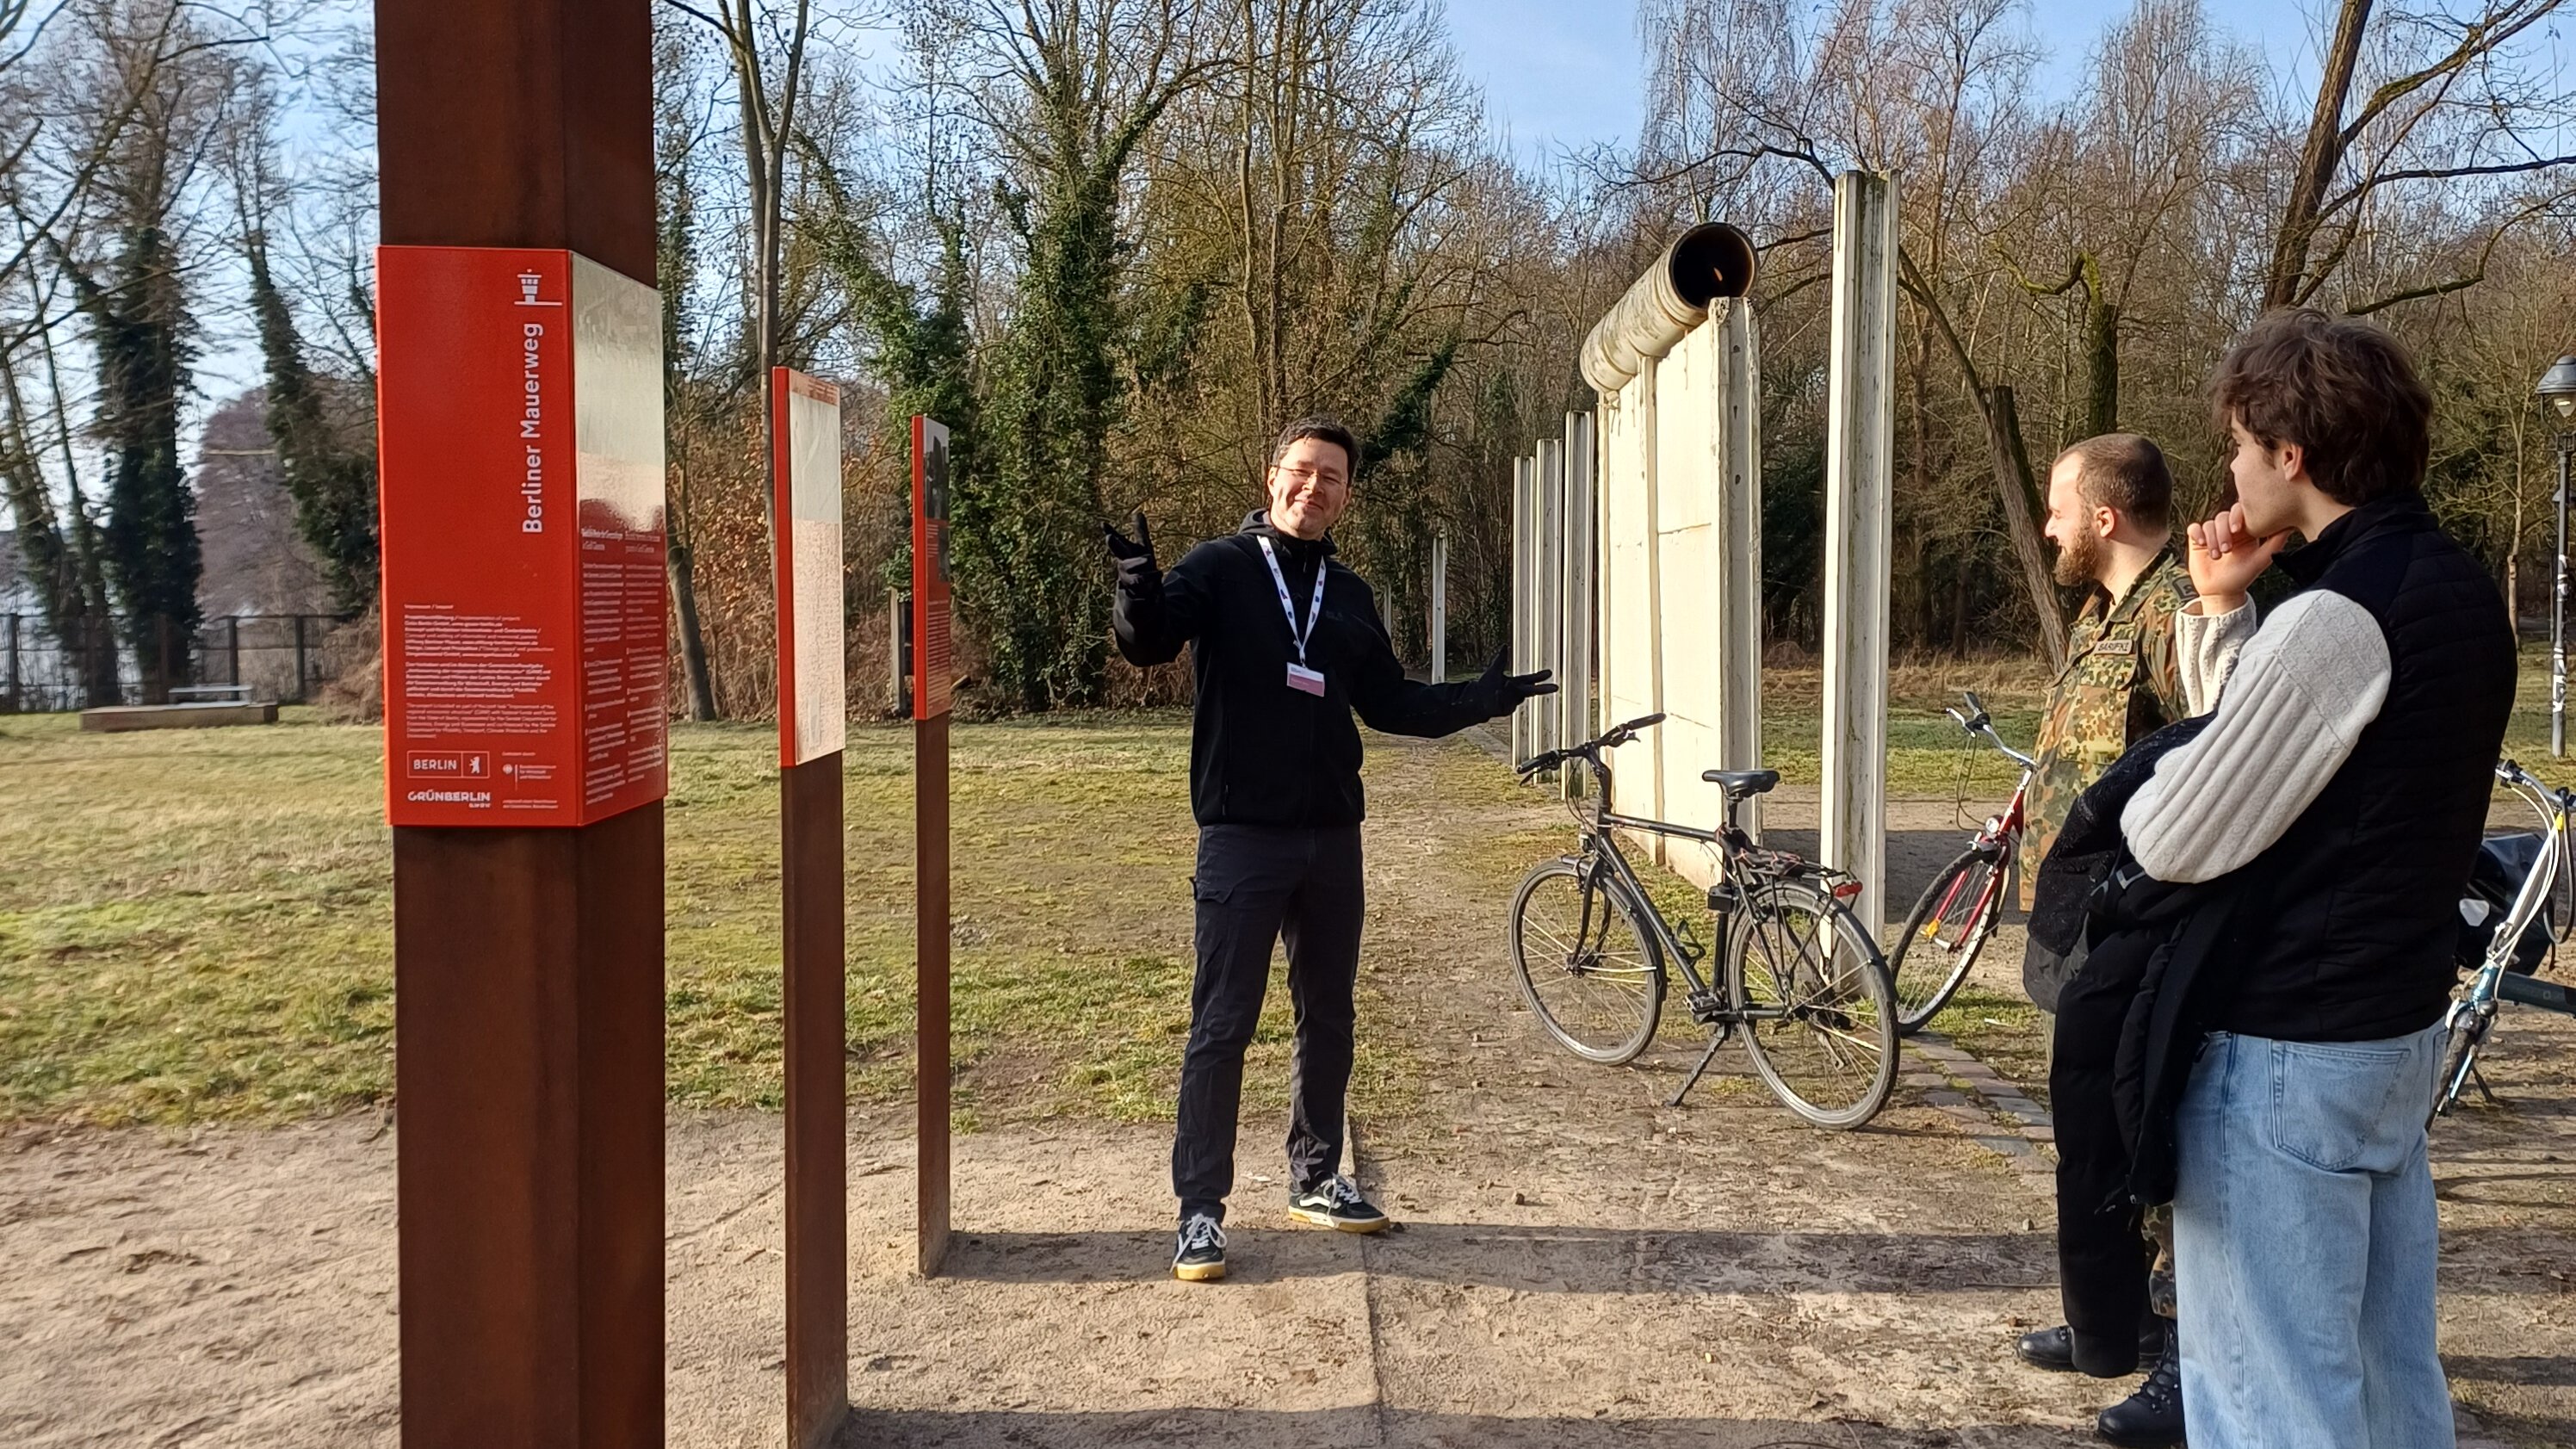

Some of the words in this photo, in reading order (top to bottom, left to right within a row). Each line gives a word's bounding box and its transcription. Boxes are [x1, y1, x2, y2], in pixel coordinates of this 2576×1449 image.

[520, 323, 543, 438] Mauerweg
[521, 445, 542, 533] Berliner
[413, 759, 457, 770] BERLIN
[407, 789, 491, 802] GRÜNBERLIN
